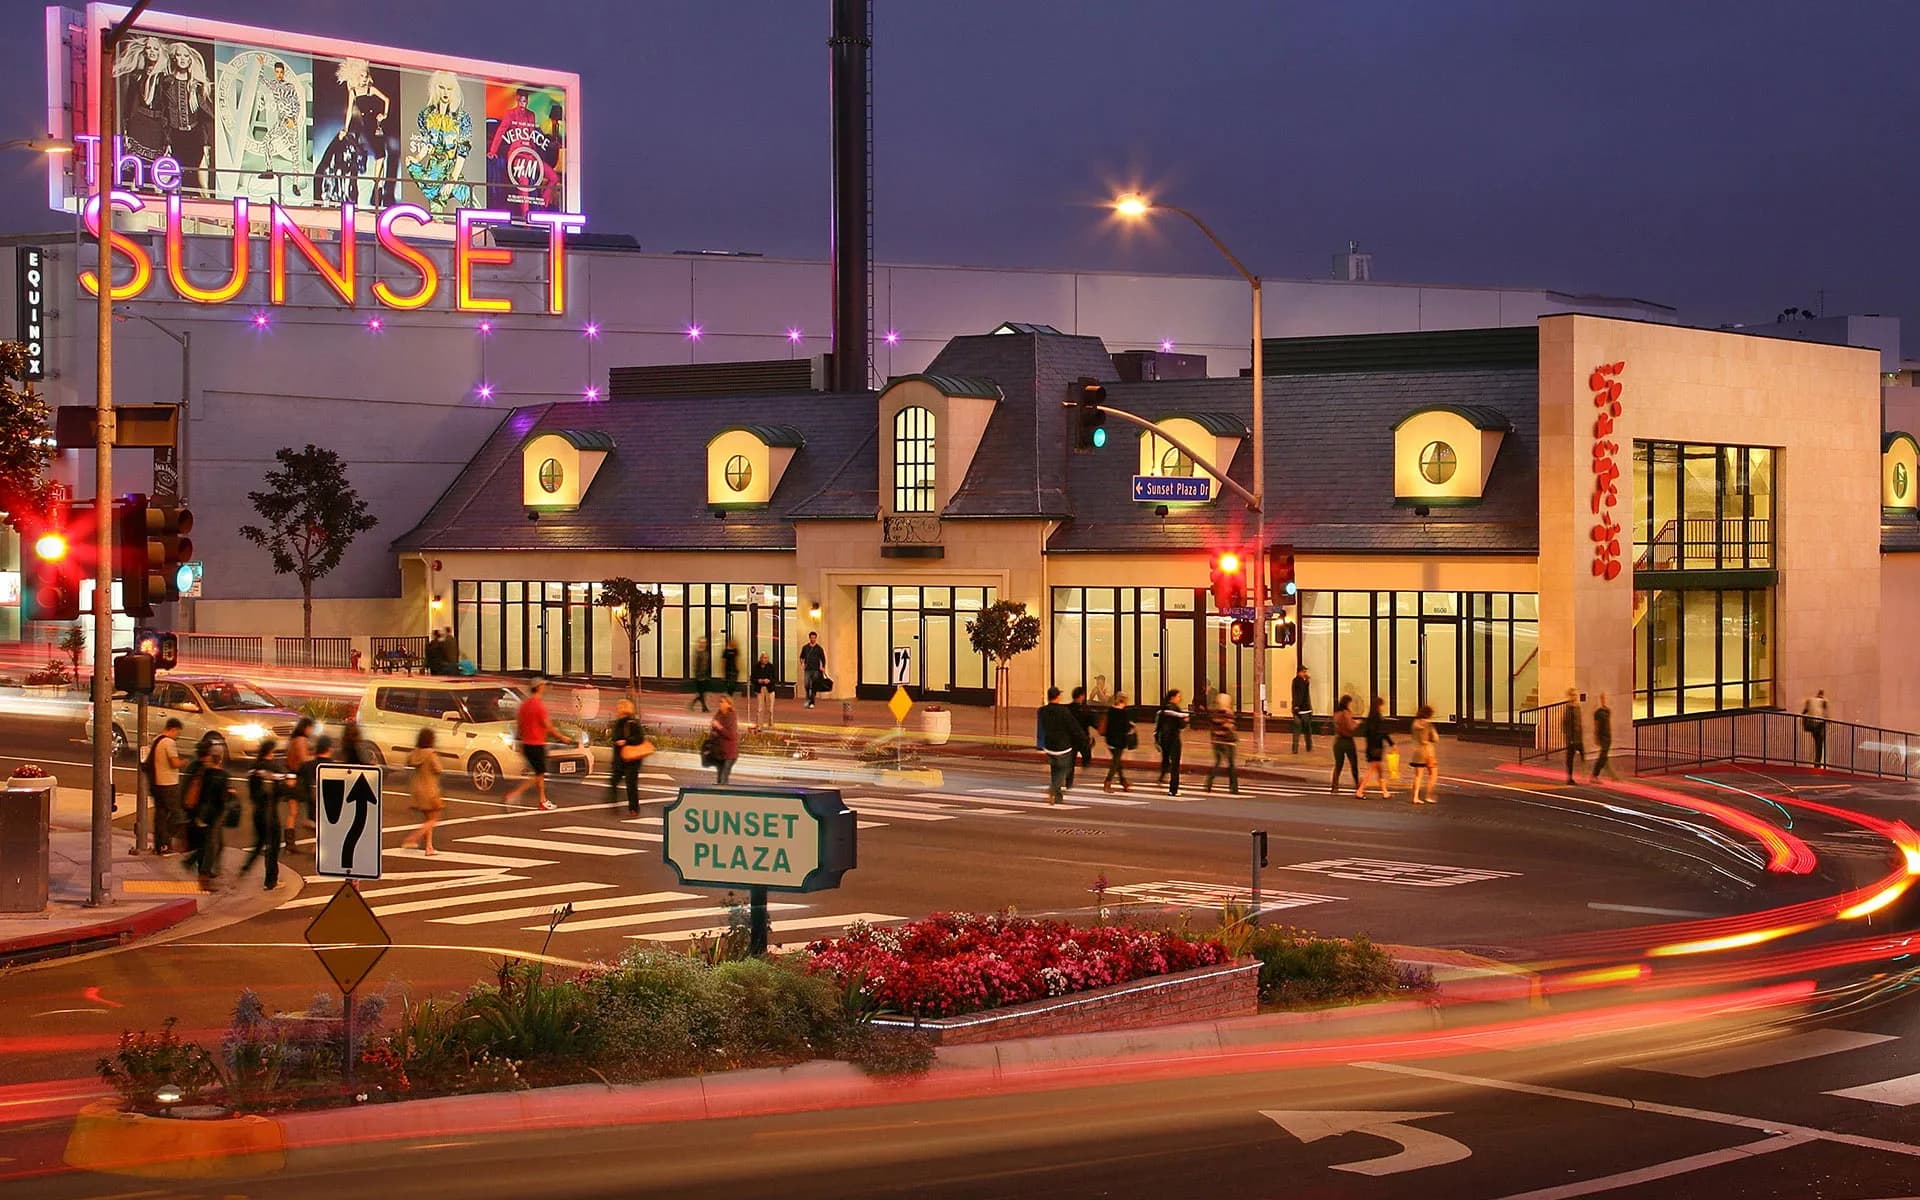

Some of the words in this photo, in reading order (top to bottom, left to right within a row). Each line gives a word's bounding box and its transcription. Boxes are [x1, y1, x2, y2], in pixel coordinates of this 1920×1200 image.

[501, 127, 551, 151] VERSACE
[74, 135, 182, 190] The
[77, 190, 587, 315] SUNSET
[27, 252, 41, 374] EQUINOX
[1147, 482, 1173, 495] Sunset
[1176, 483, 1197, 495] Plaza
[1200, 483, 1208, 495] Dr
[684, 808, 799, 839] SUNSET
[693, 842, 792, 873] PLAZA
